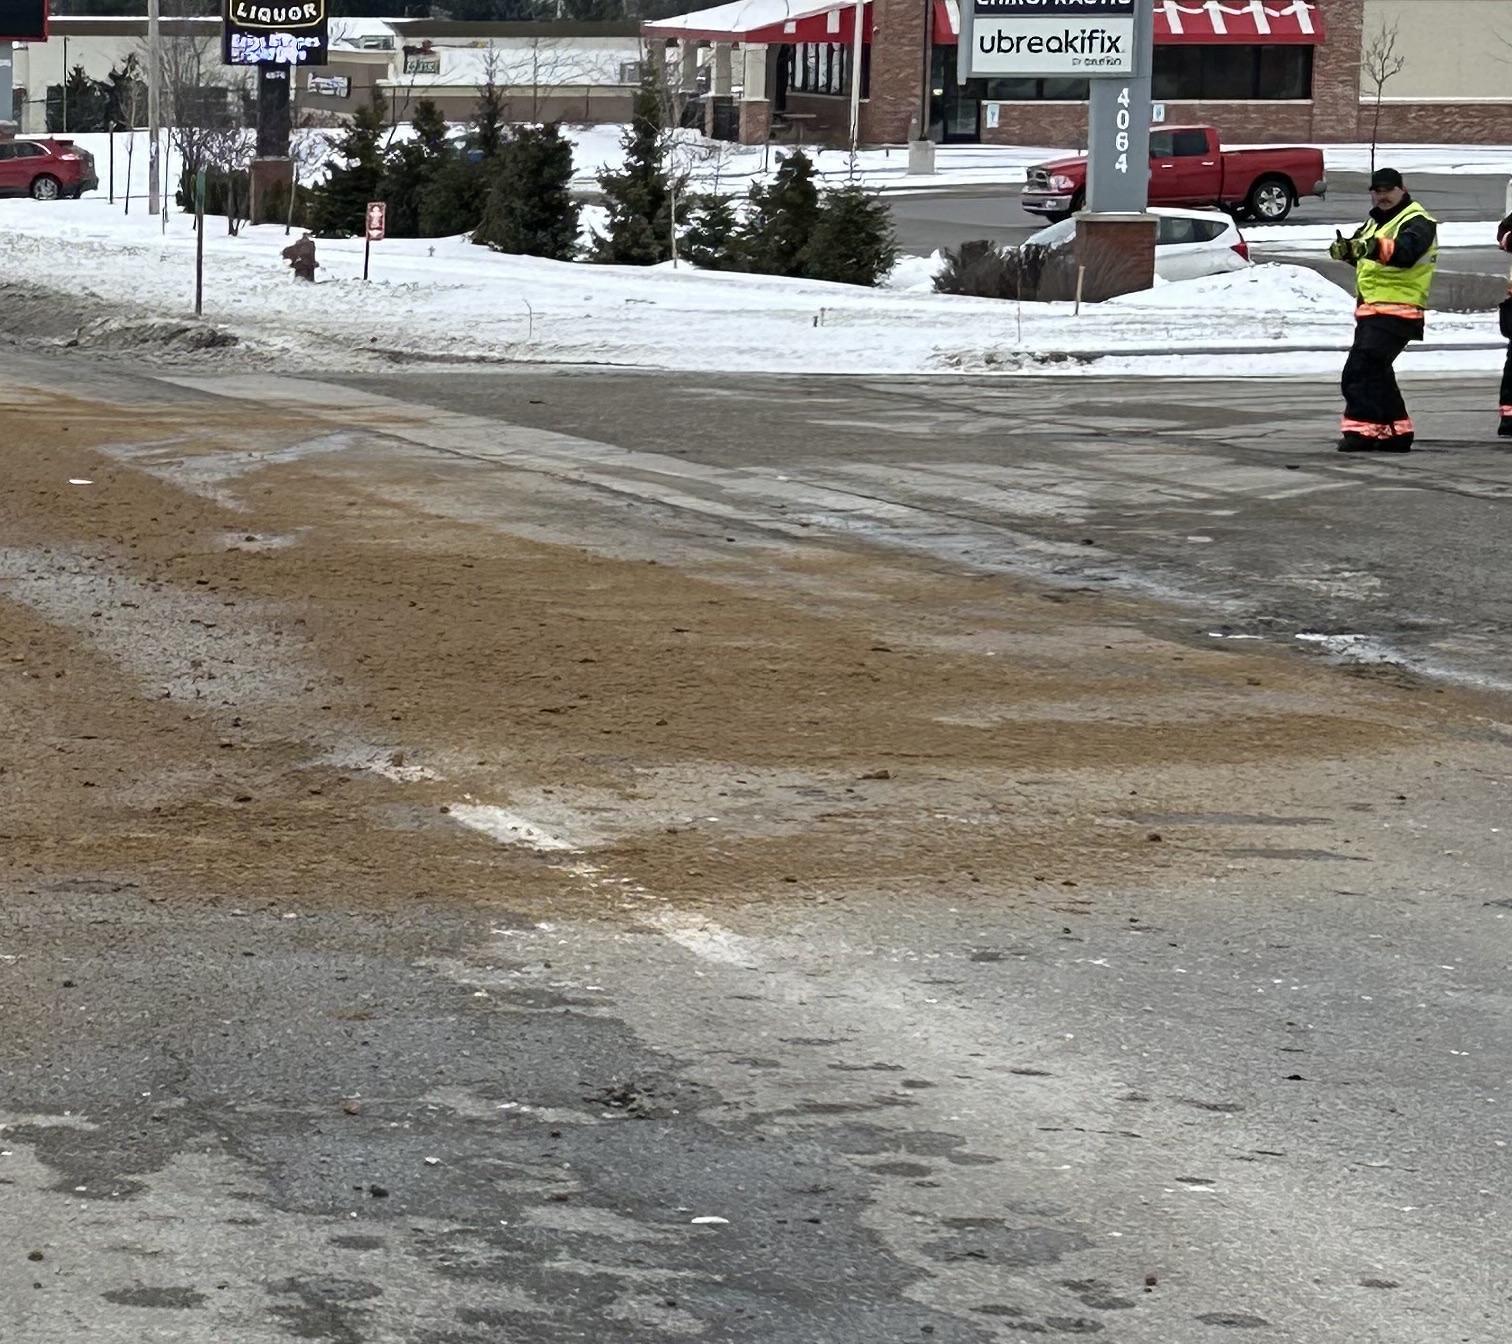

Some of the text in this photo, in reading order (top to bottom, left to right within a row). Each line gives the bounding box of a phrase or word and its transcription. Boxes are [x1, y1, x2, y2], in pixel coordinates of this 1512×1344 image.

[236, 2, 317, 23] LIQUOR
[979, 29, 1122, 54] ubreakifix
[1115, 87, 1130, 174] 4064
